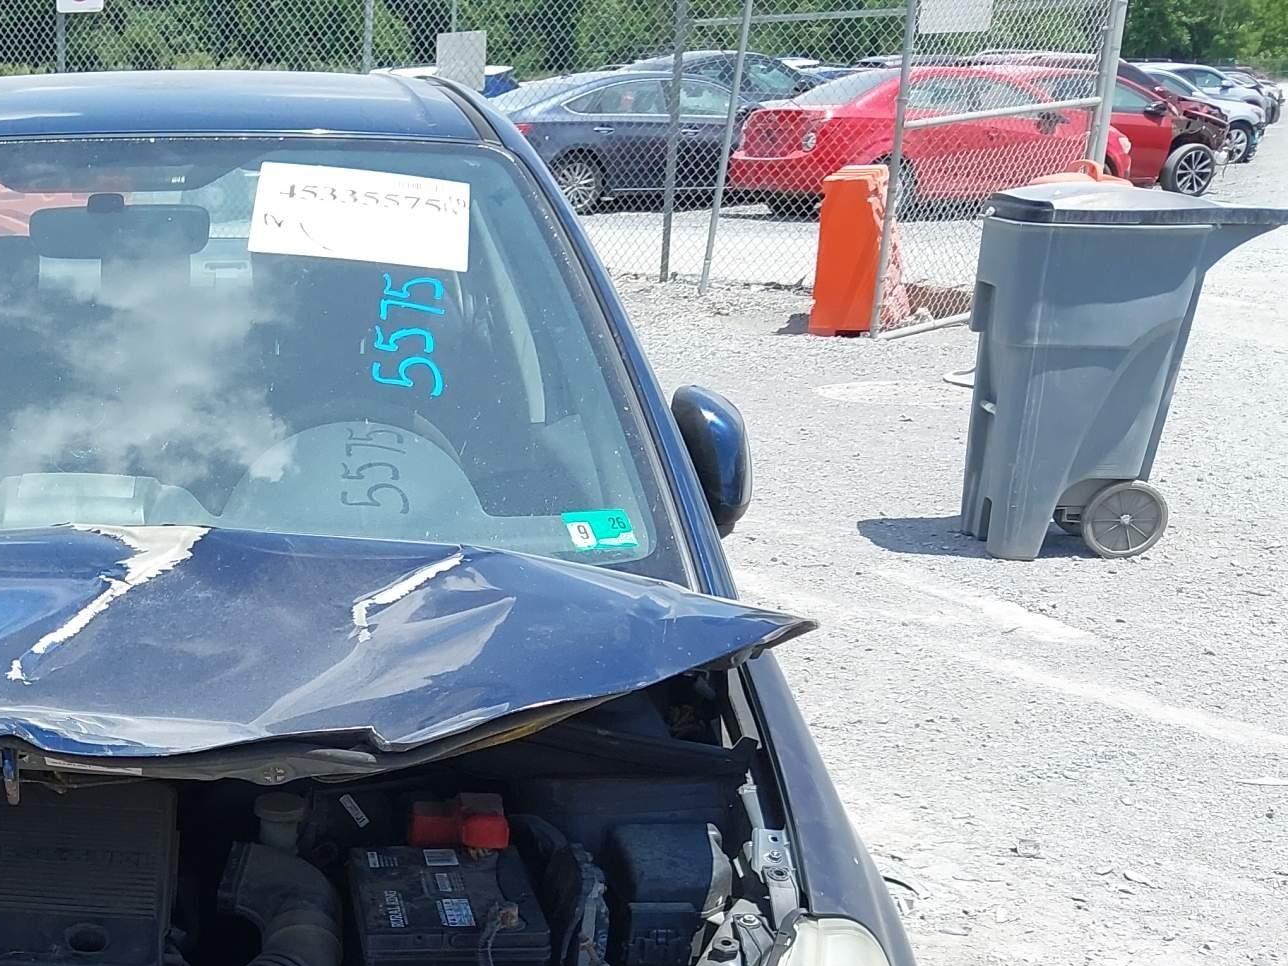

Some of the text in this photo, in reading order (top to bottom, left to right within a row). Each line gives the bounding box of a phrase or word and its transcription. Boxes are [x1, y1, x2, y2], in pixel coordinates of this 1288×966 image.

[372, 272, 445, 397] 5575
[577, 516, 626, 539] 9 26
